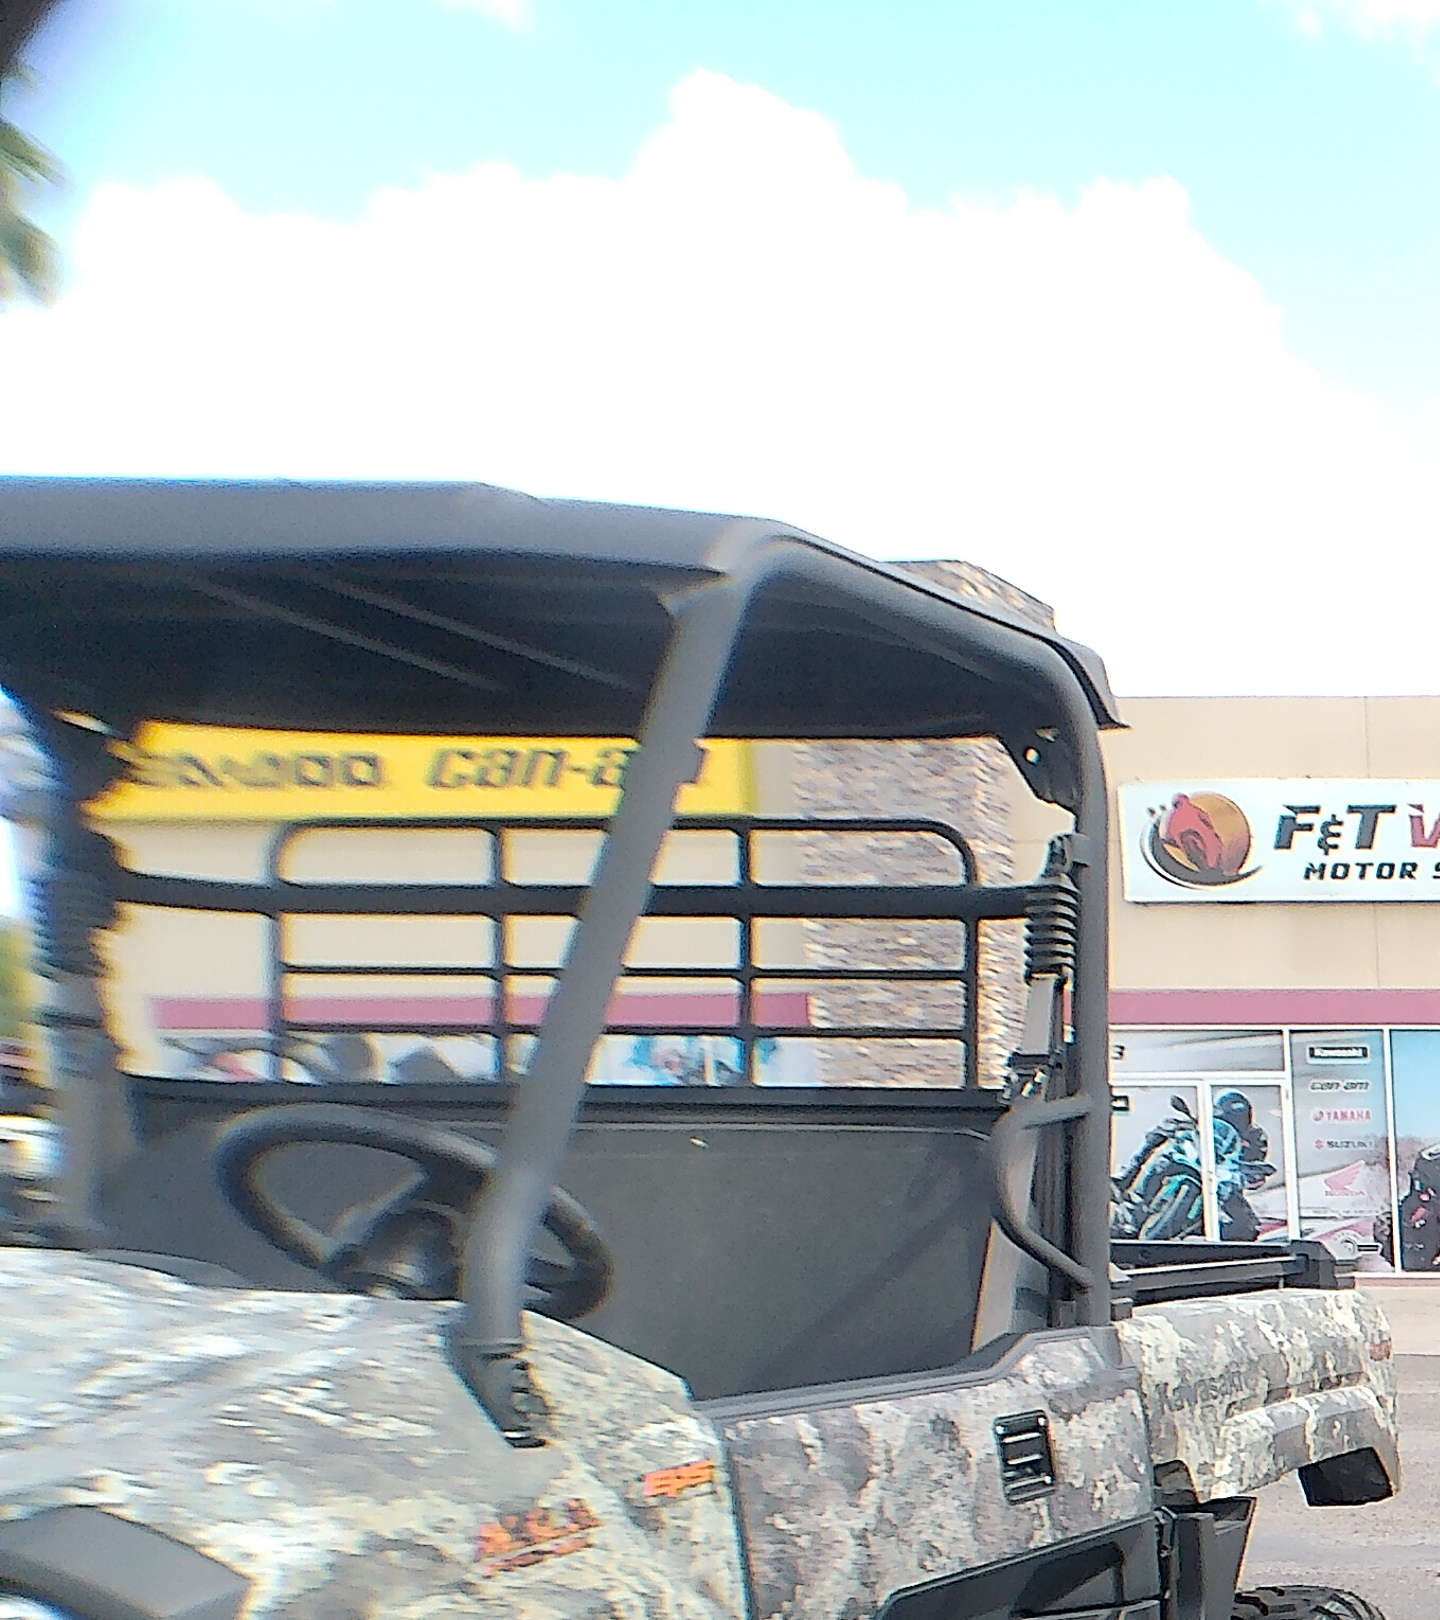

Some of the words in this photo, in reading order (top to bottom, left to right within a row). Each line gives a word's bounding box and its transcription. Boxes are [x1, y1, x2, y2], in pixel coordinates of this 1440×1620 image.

[1273, 803, 1398, 855] F&T
[1303, 861, 1418, 881] MOTOR
[1327, 1110, 1372, 1122] YAMAHA
[1327, 1140, 1373, 1150] SUZUKI
